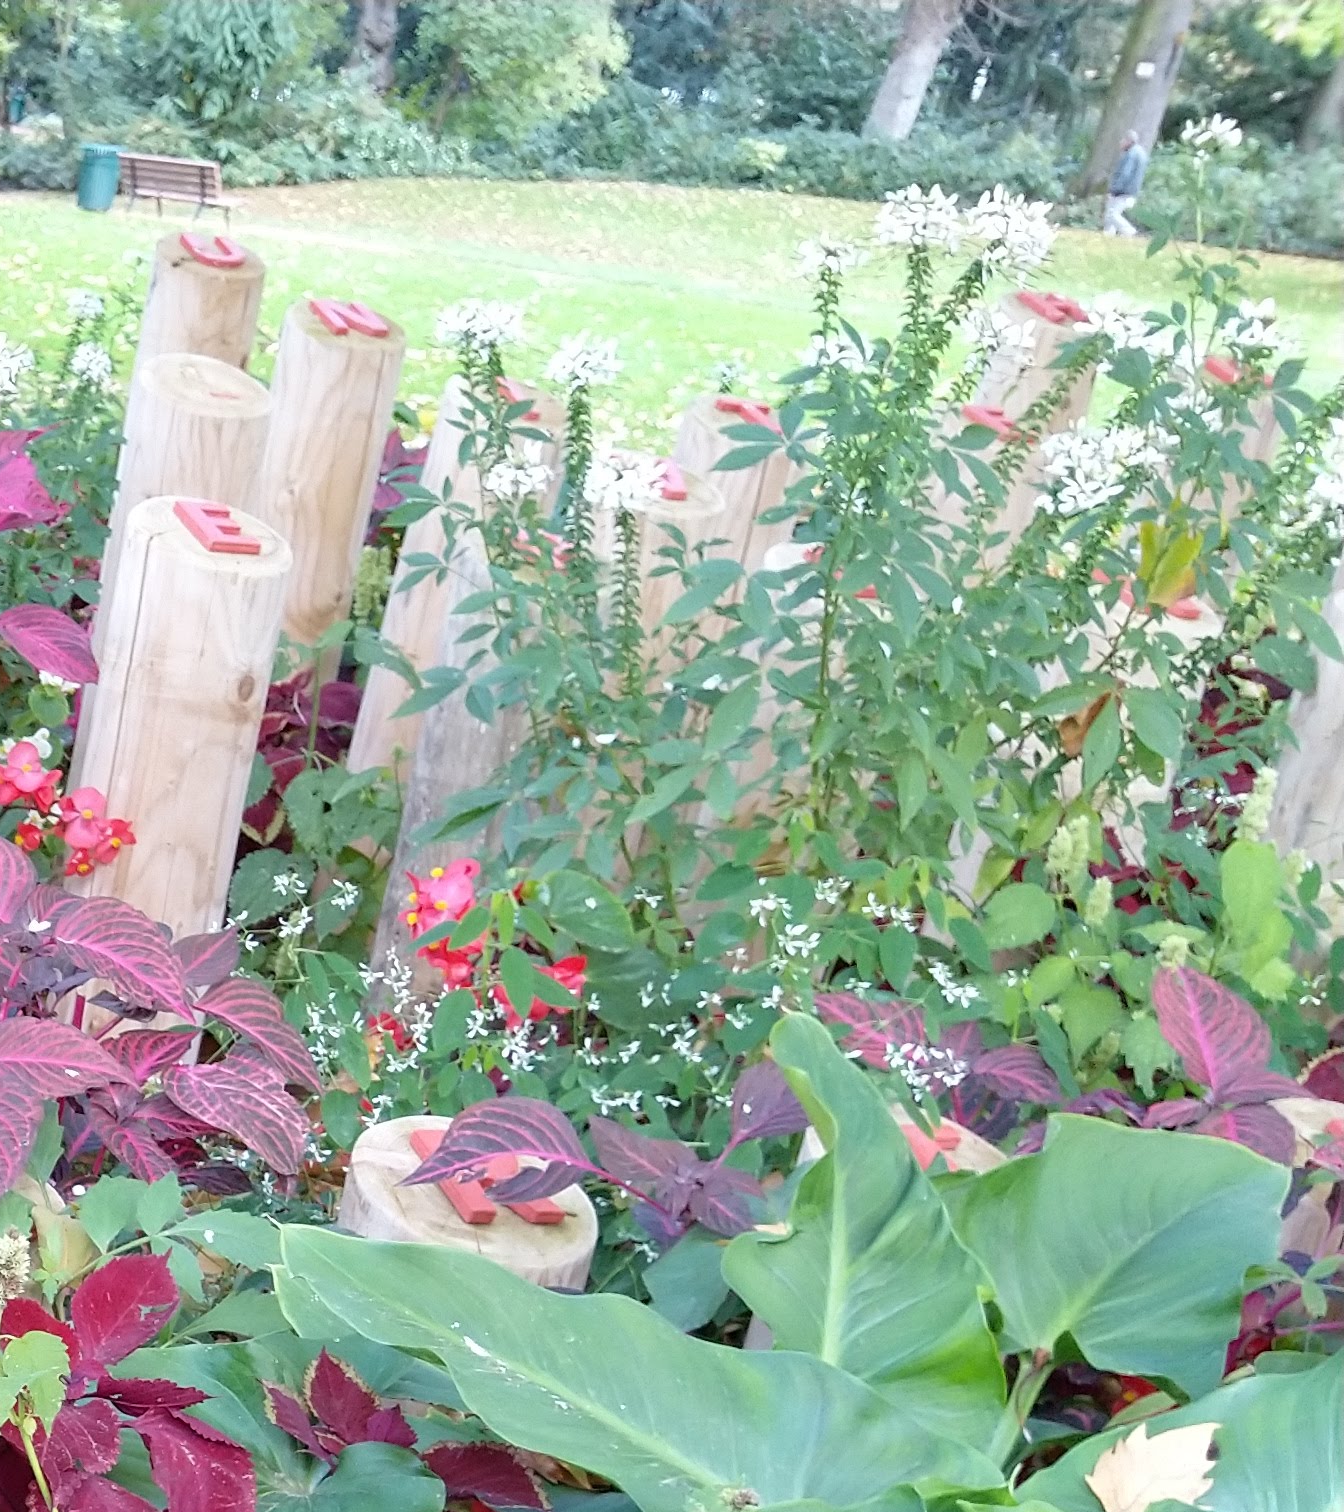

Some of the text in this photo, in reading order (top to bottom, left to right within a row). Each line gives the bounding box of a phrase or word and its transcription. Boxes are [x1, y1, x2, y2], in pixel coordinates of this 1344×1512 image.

[180, 232, 245, 268] U
[309, 299, 389, 337] N
[173, 501, 261, 555] E
